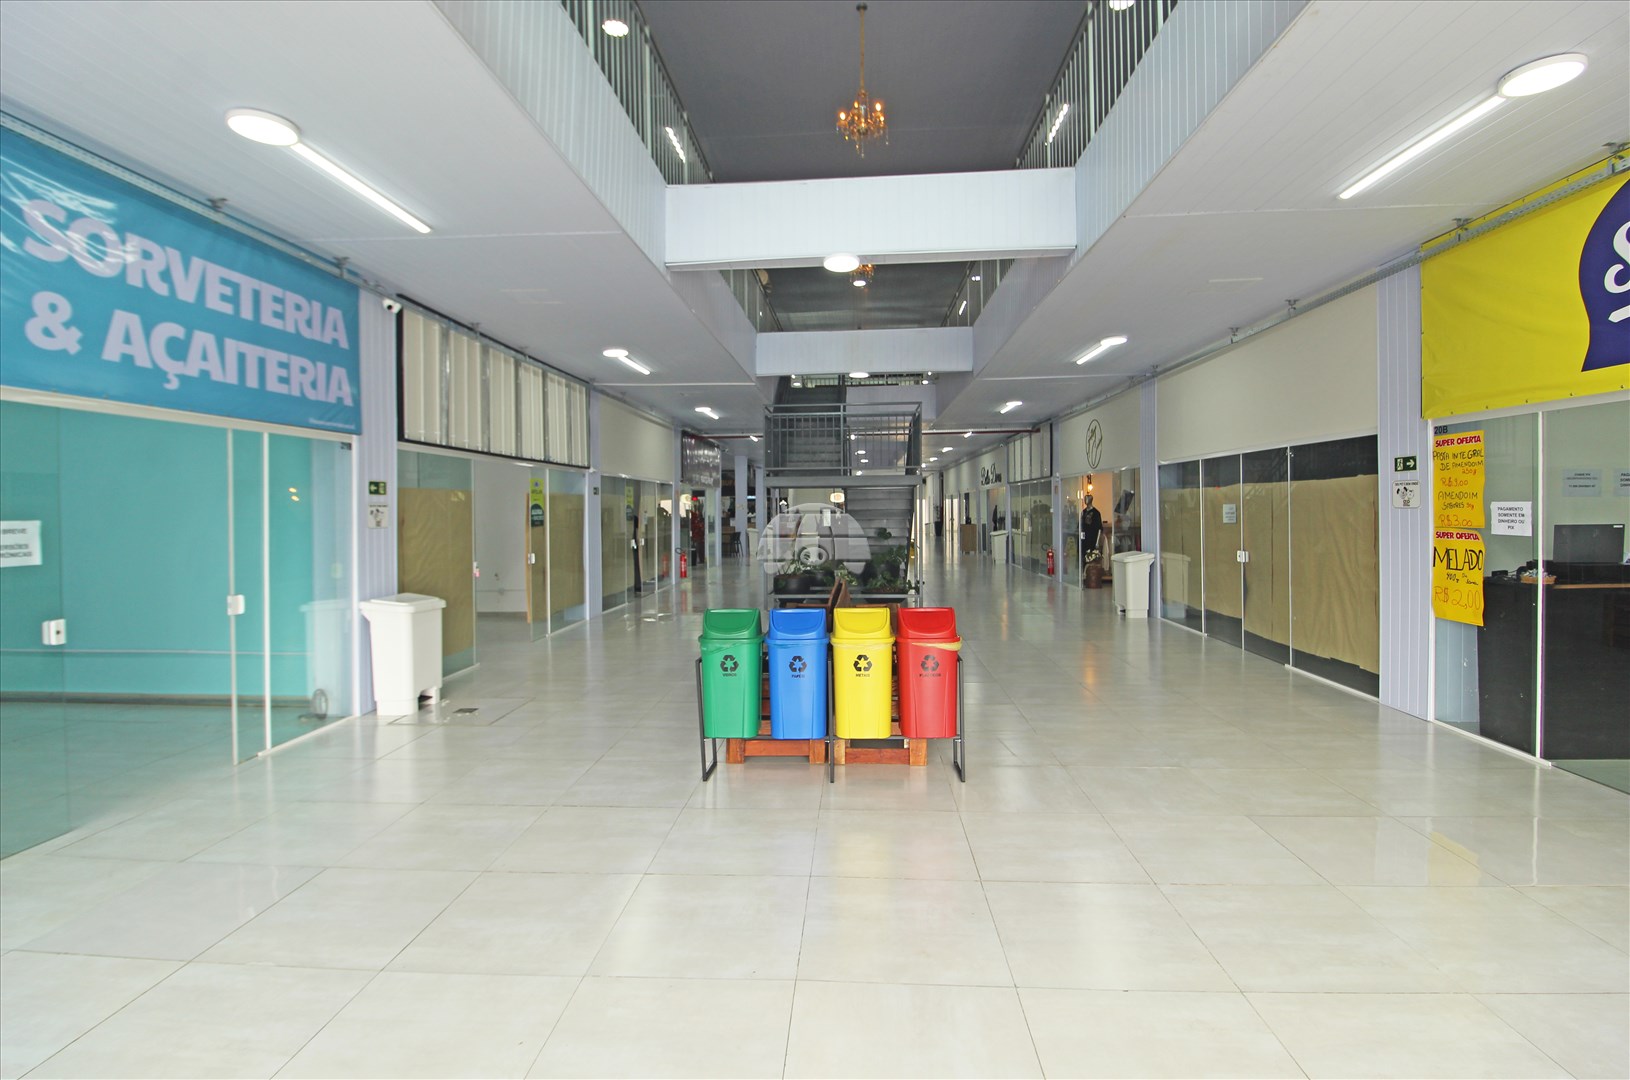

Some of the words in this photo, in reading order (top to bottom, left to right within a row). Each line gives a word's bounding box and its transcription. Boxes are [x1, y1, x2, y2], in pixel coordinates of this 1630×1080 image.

[22, 199, 349, 350] SORVETERIA
[24, 291, 83, 355] &
[101, 309, 354, 407] AÇAITERIA
[1434, 425, 1448, 434] 20B
[1435, 438, 1454, 448] SUPER
[1456, 435, 1481, 445] OFERTA
[1439, 462, 1451, 471] DE
[1452, 460, 1484, 469] AMENDOIM
[1438, 490, 1478, 501] AMENDOIM
[1435, 531, 1454, 539] SUPER
[1456, 532, 1480, 541] OFERTA
[1433, 546, 1484, 571] MELADO
